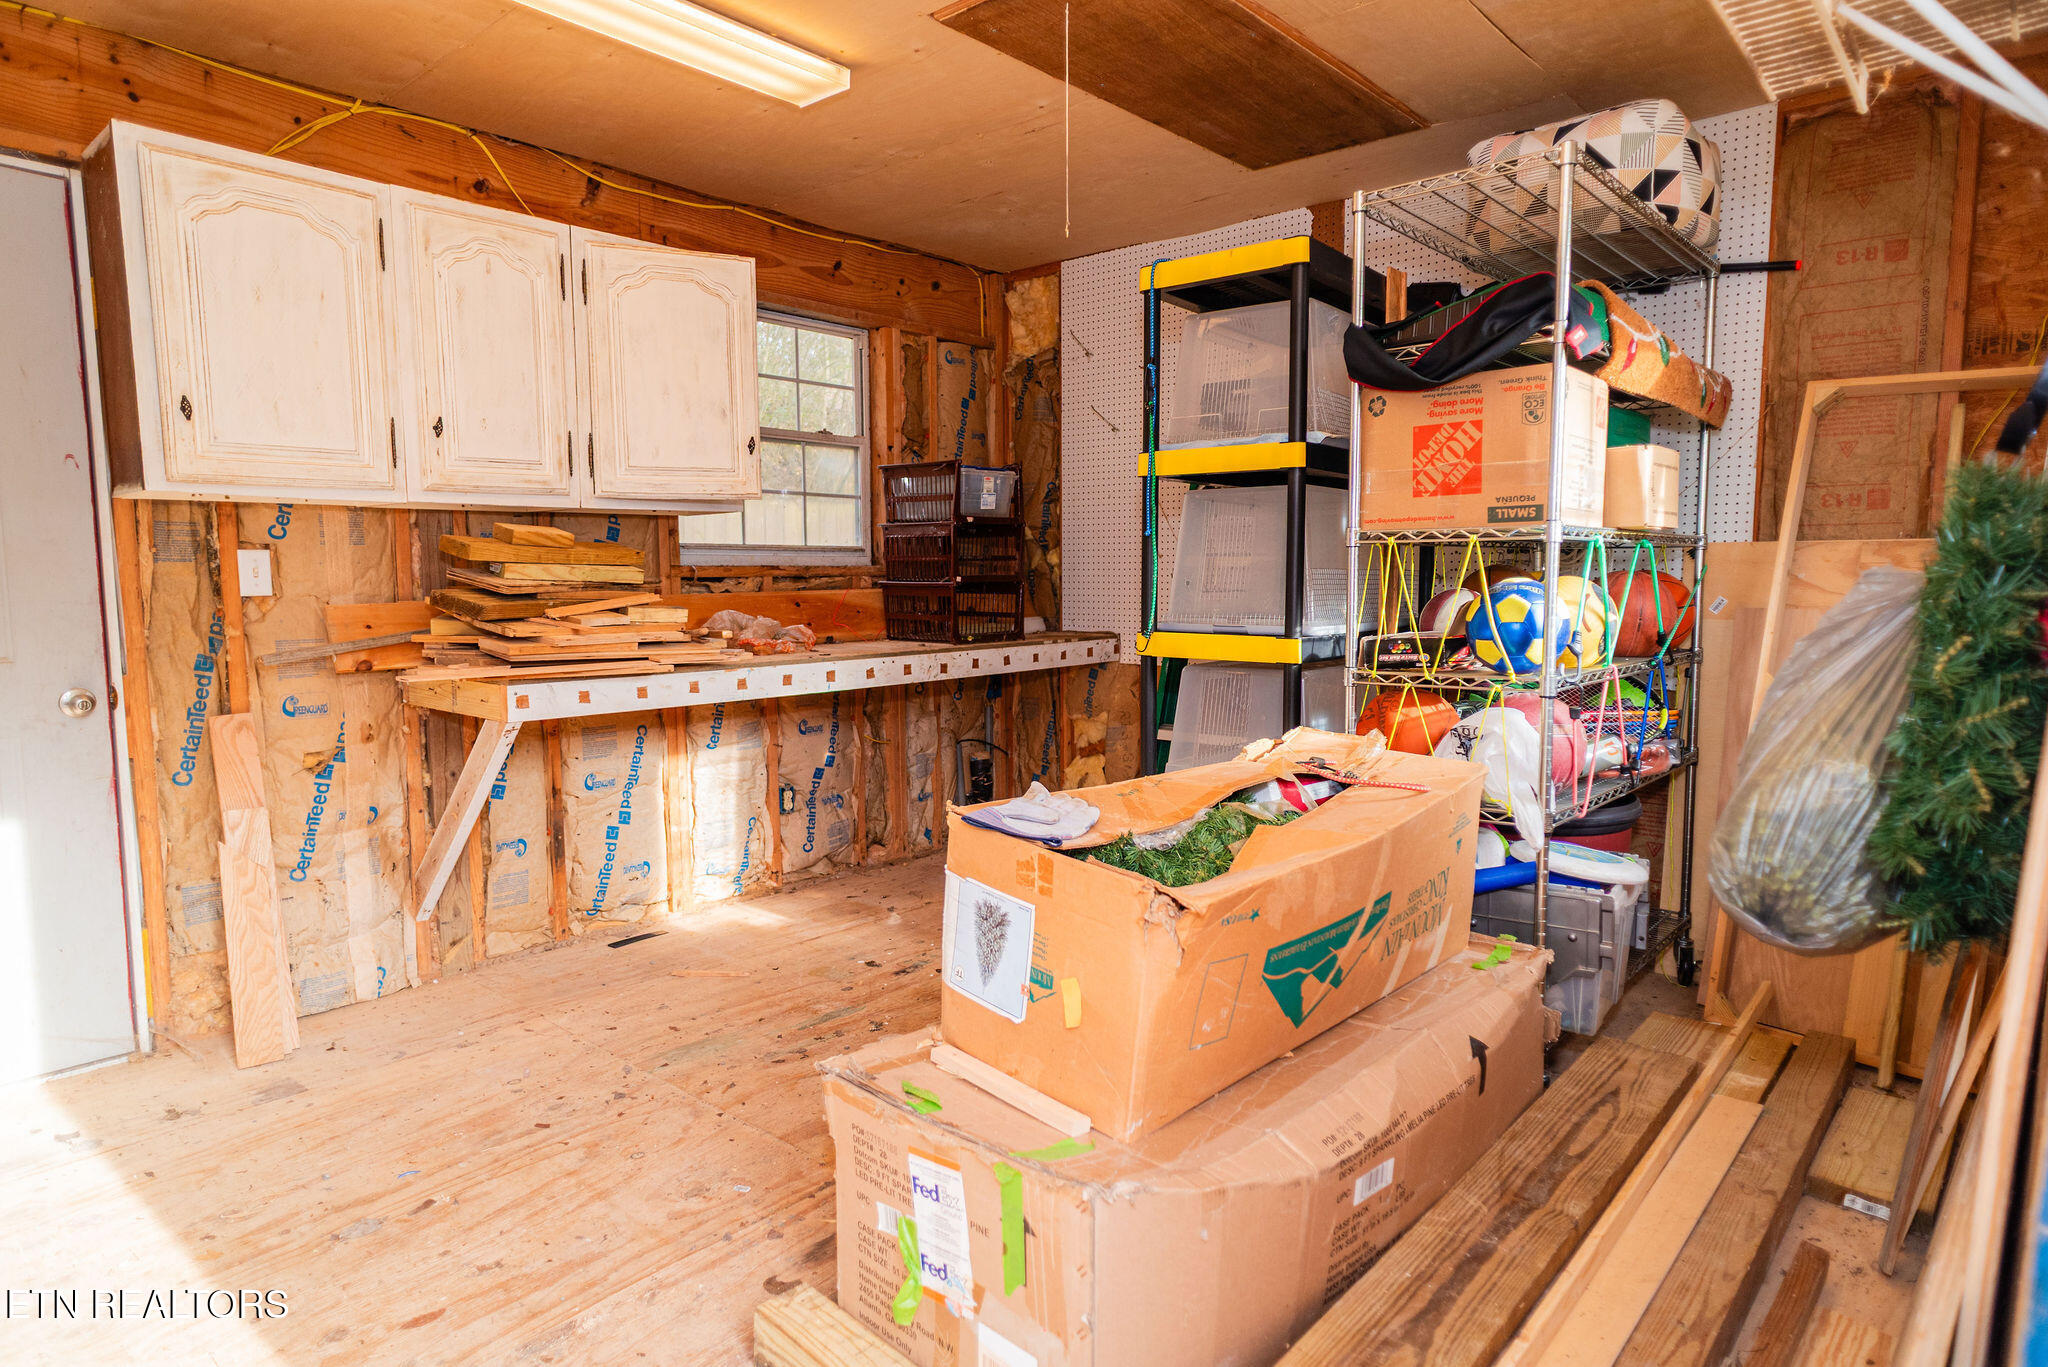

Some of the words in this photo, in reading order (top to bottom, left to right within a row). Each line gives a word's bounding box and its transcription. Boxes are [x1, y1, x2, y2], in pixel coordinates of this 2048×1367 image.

[1525, 375, 1547, 383] Think
[1430, 400, 1458, 409] doing.
[1460, 397, 1484, 406] More
[1460, 407, 1483, 415] More
[1524, 400, 1545, 410] ECO
[1427, 408, 1458, 419] saving.
[1413, 423, 1456, 469] DEPOT
[1412, 421, 1483, 497] HOME
[1445, 458, 1476, 488] THE
[1495, 495, 1536, 505] PEQUEÑA
[1495, 507, 1537, 519] SMALL
[172, 669, 213, 786] CertainTeed
[619, 725, 648, 809] CertainTeed
[289, 782, 332, 882] CertainTeed
[585, 842, 617, 916] CrtainTeed
[856, 1167, 869, 1182] LED
[970, 1220, 990, 1239] PINE
[859, 1310, 880, 1330] Indoor
[882, 1326, 895, 1341] Use
[896, 1337, 912, 1355] Only
[916, 1321, 935, 1341] Road
